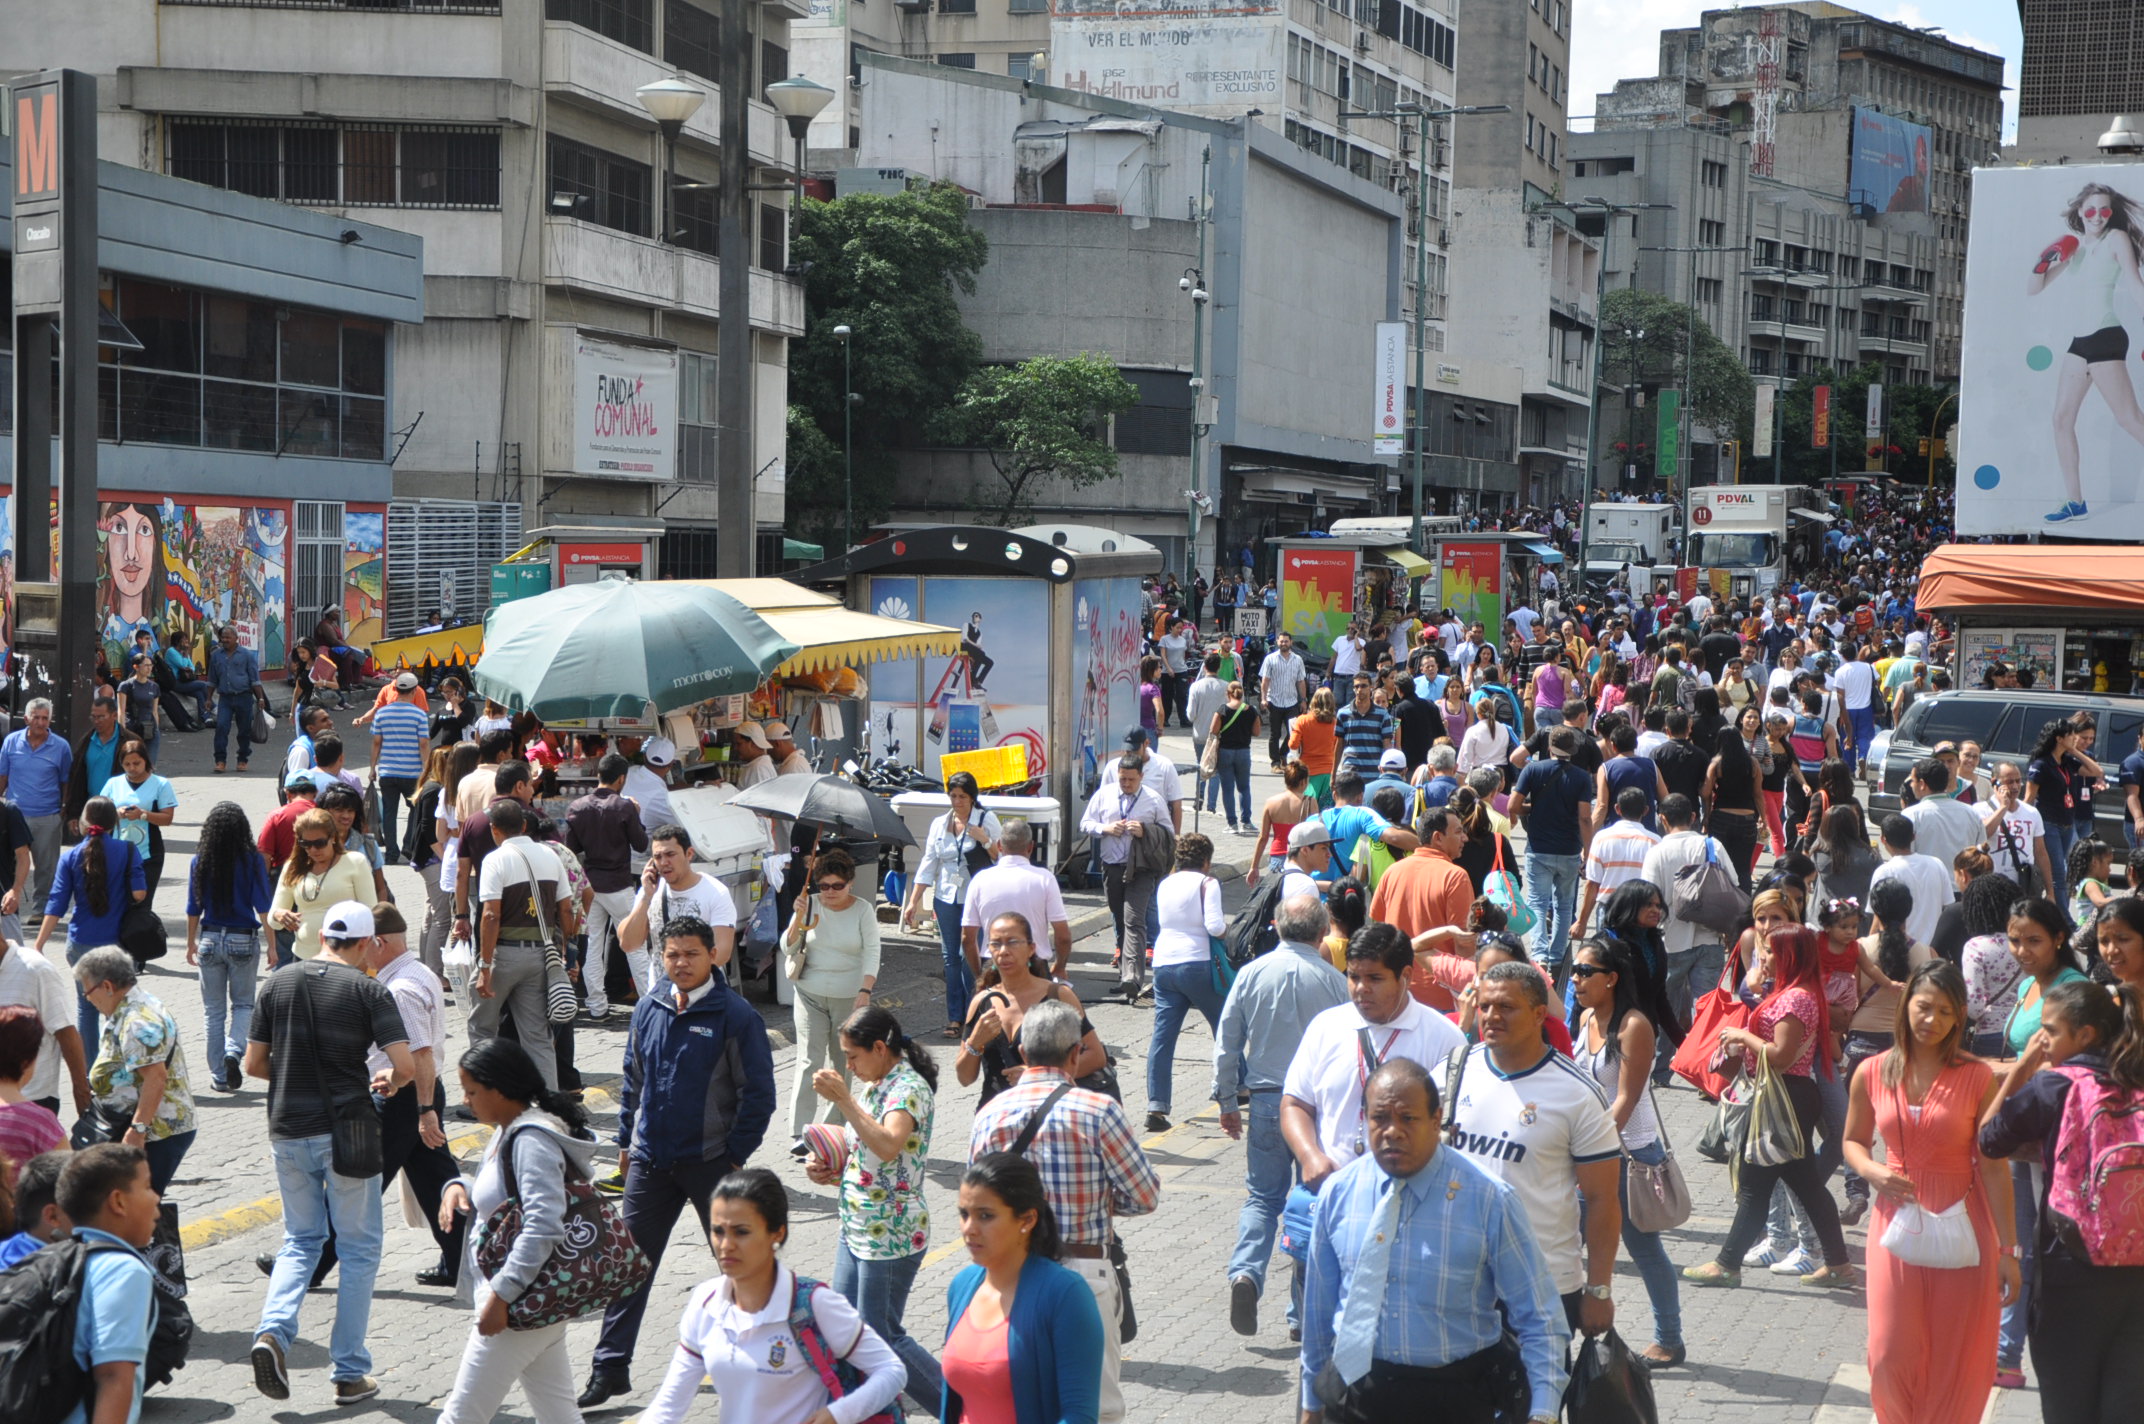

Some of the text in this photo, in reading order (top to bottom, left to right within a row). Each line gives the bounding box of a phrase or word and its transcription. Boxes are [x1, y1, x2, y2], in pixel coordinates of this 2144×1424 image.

[1089, 32, 1113, 47] VER
[1120, 31, 1134, 46] EL
[1216, 81, 1275, 93] EXCLUSIVO
[18, 93, 56, 194] M
[598, 374, 634, 405] FUNDA
[595, 402, 658, 437] COMUNAL
[1716, 494, 1756, 504] PDVAL
[1697, 509, 1706, 519] 11
[673, 665, 734, 689] morrocoy
[1454, 1122, 1527, 1163] bwin
